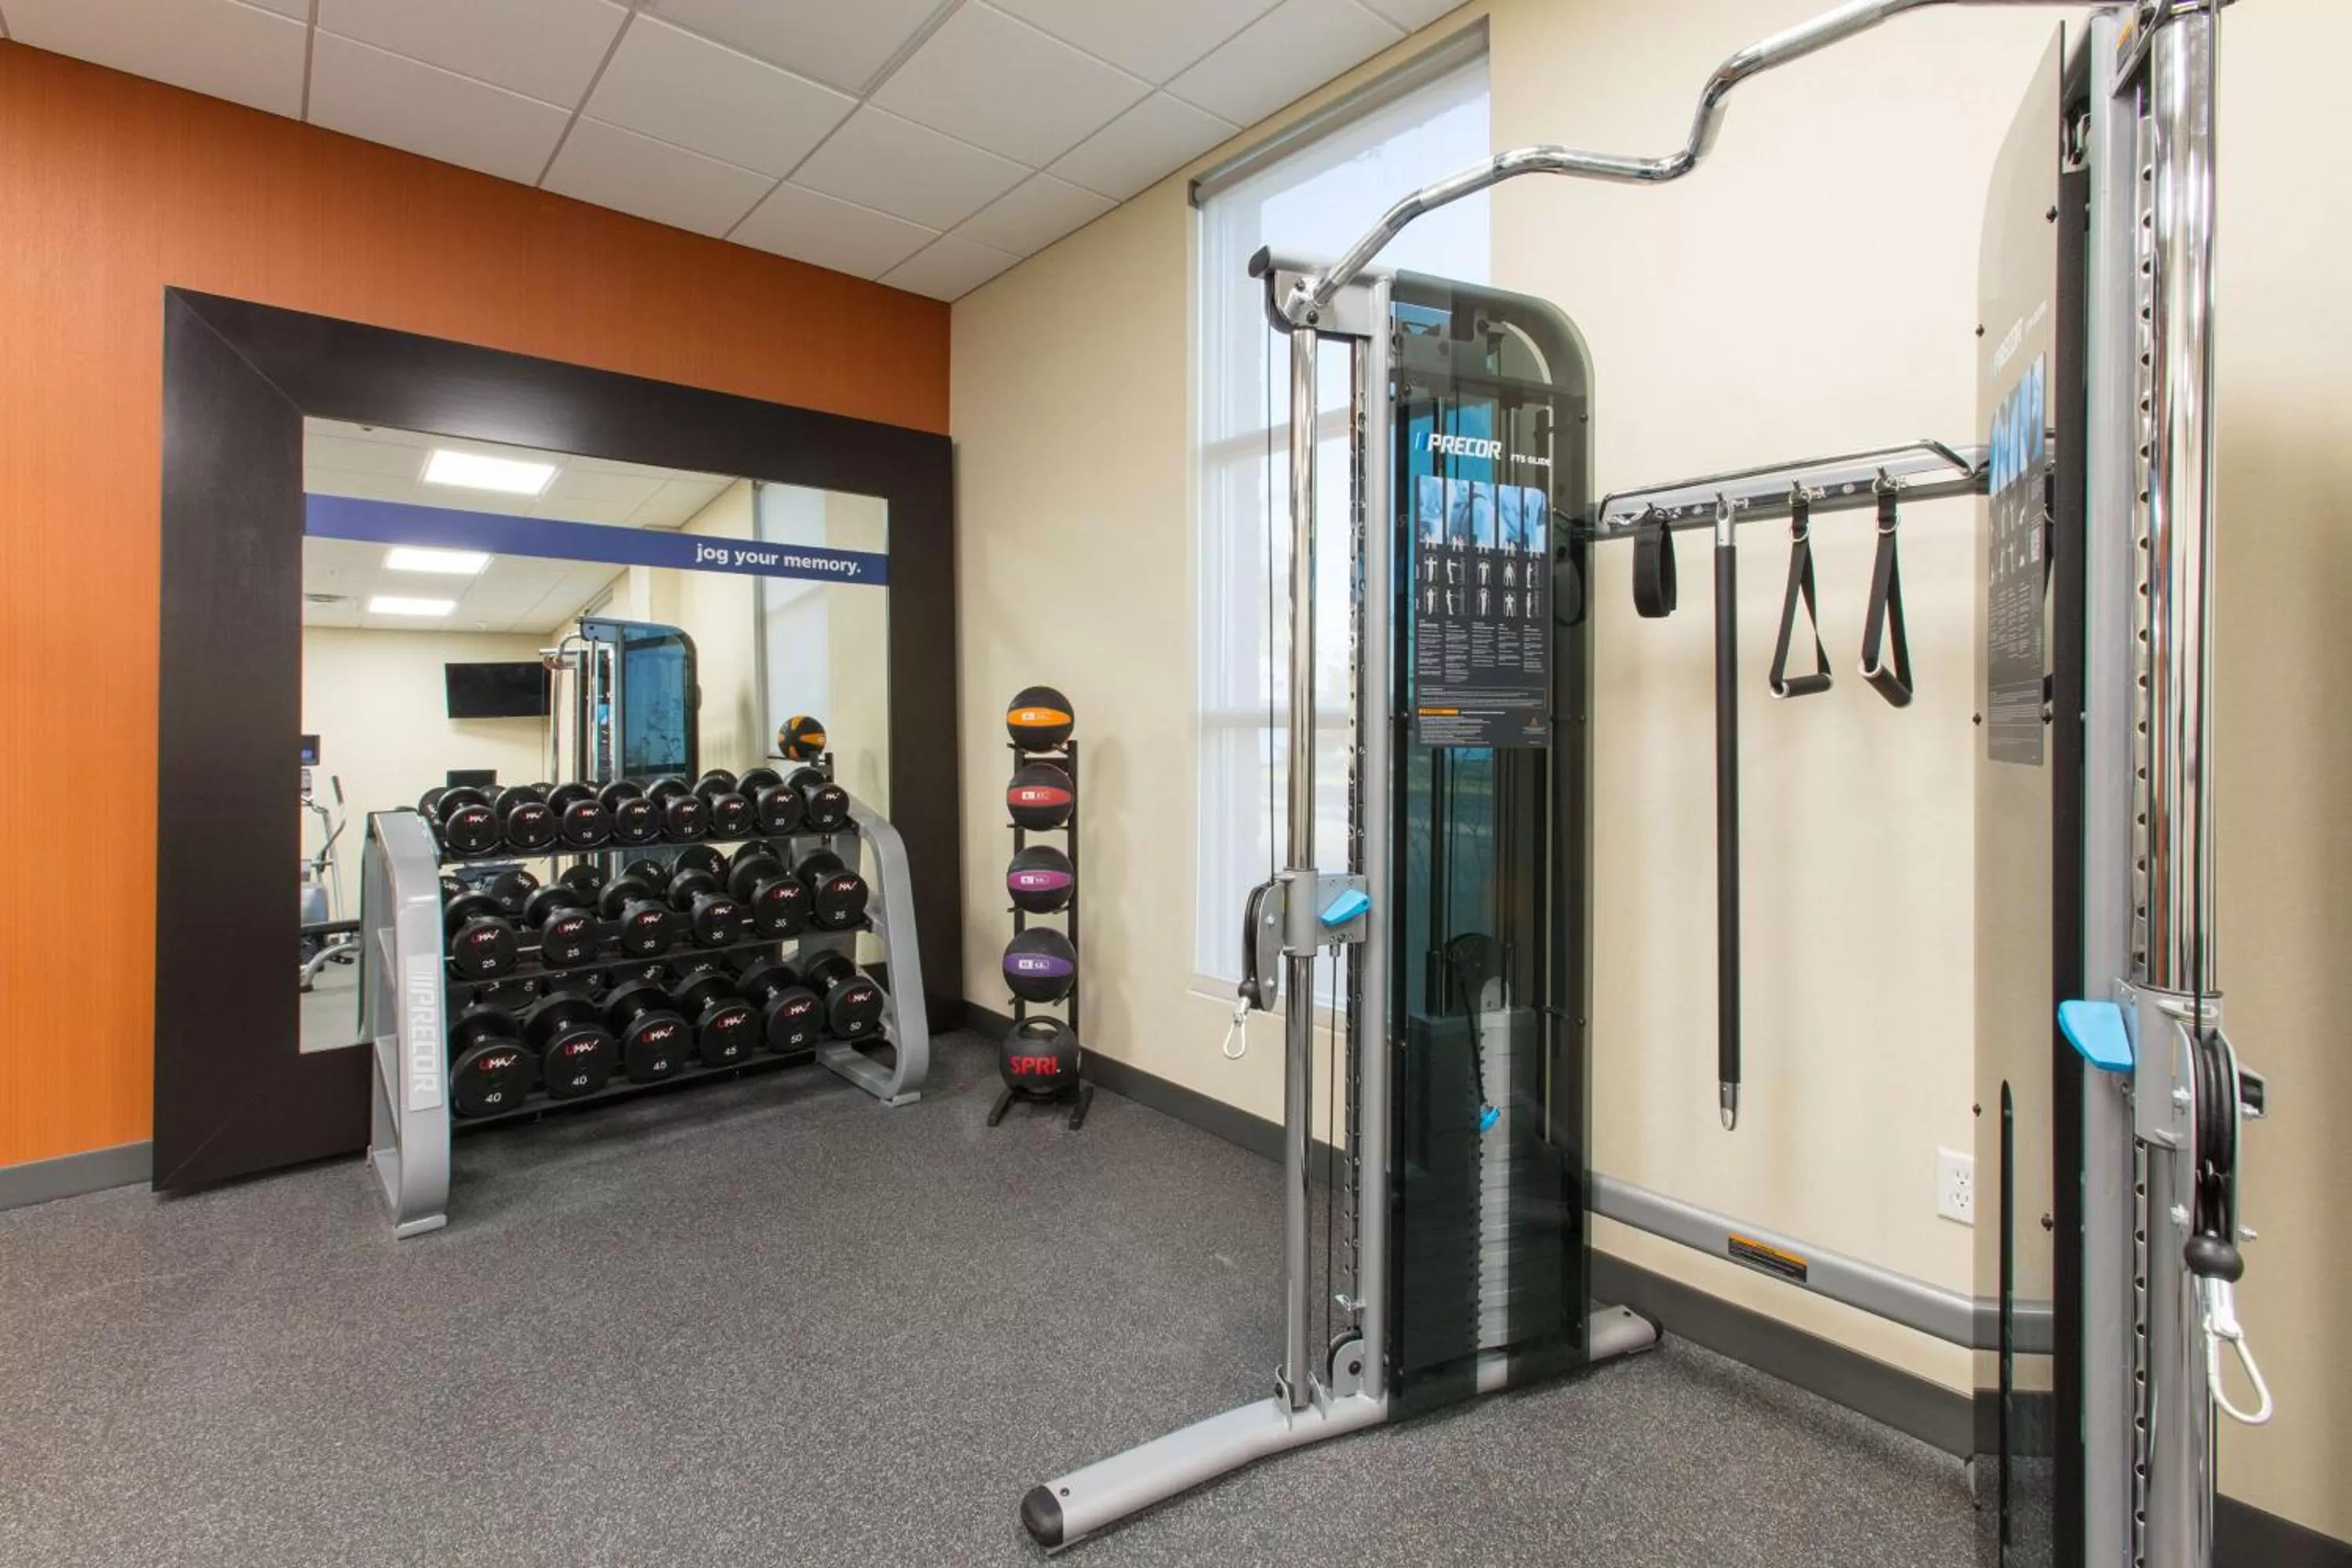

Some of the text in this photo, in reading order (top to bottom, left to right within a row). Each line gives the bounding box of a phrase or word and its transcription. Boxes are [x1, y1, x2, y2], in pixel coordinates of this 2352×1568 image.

[1427, 434, 1502, 459] PRECOR
[695, 543, 862, 576] jog your memory.
[712, 931, 724, 940] 30
[644, 939, 656, 949] 30
[567, 948, 580, 958] 25
[482, 959, 496, 969] 25
[849, 1022, 862, 1031] 50
[411, 986, 437, 1092] PRECOR
[790, 1033, 804, 1044] 50
[565, 1039, 600, 1055] UMAX
[724, 1047, 738, 1056] 45
[478, 1054, 517, 1071] UMAX
[652, 1058, 668, 1071] 45
[572, 1075, 588, 1086] 40
[485, 1092, 503, 1103] 40
